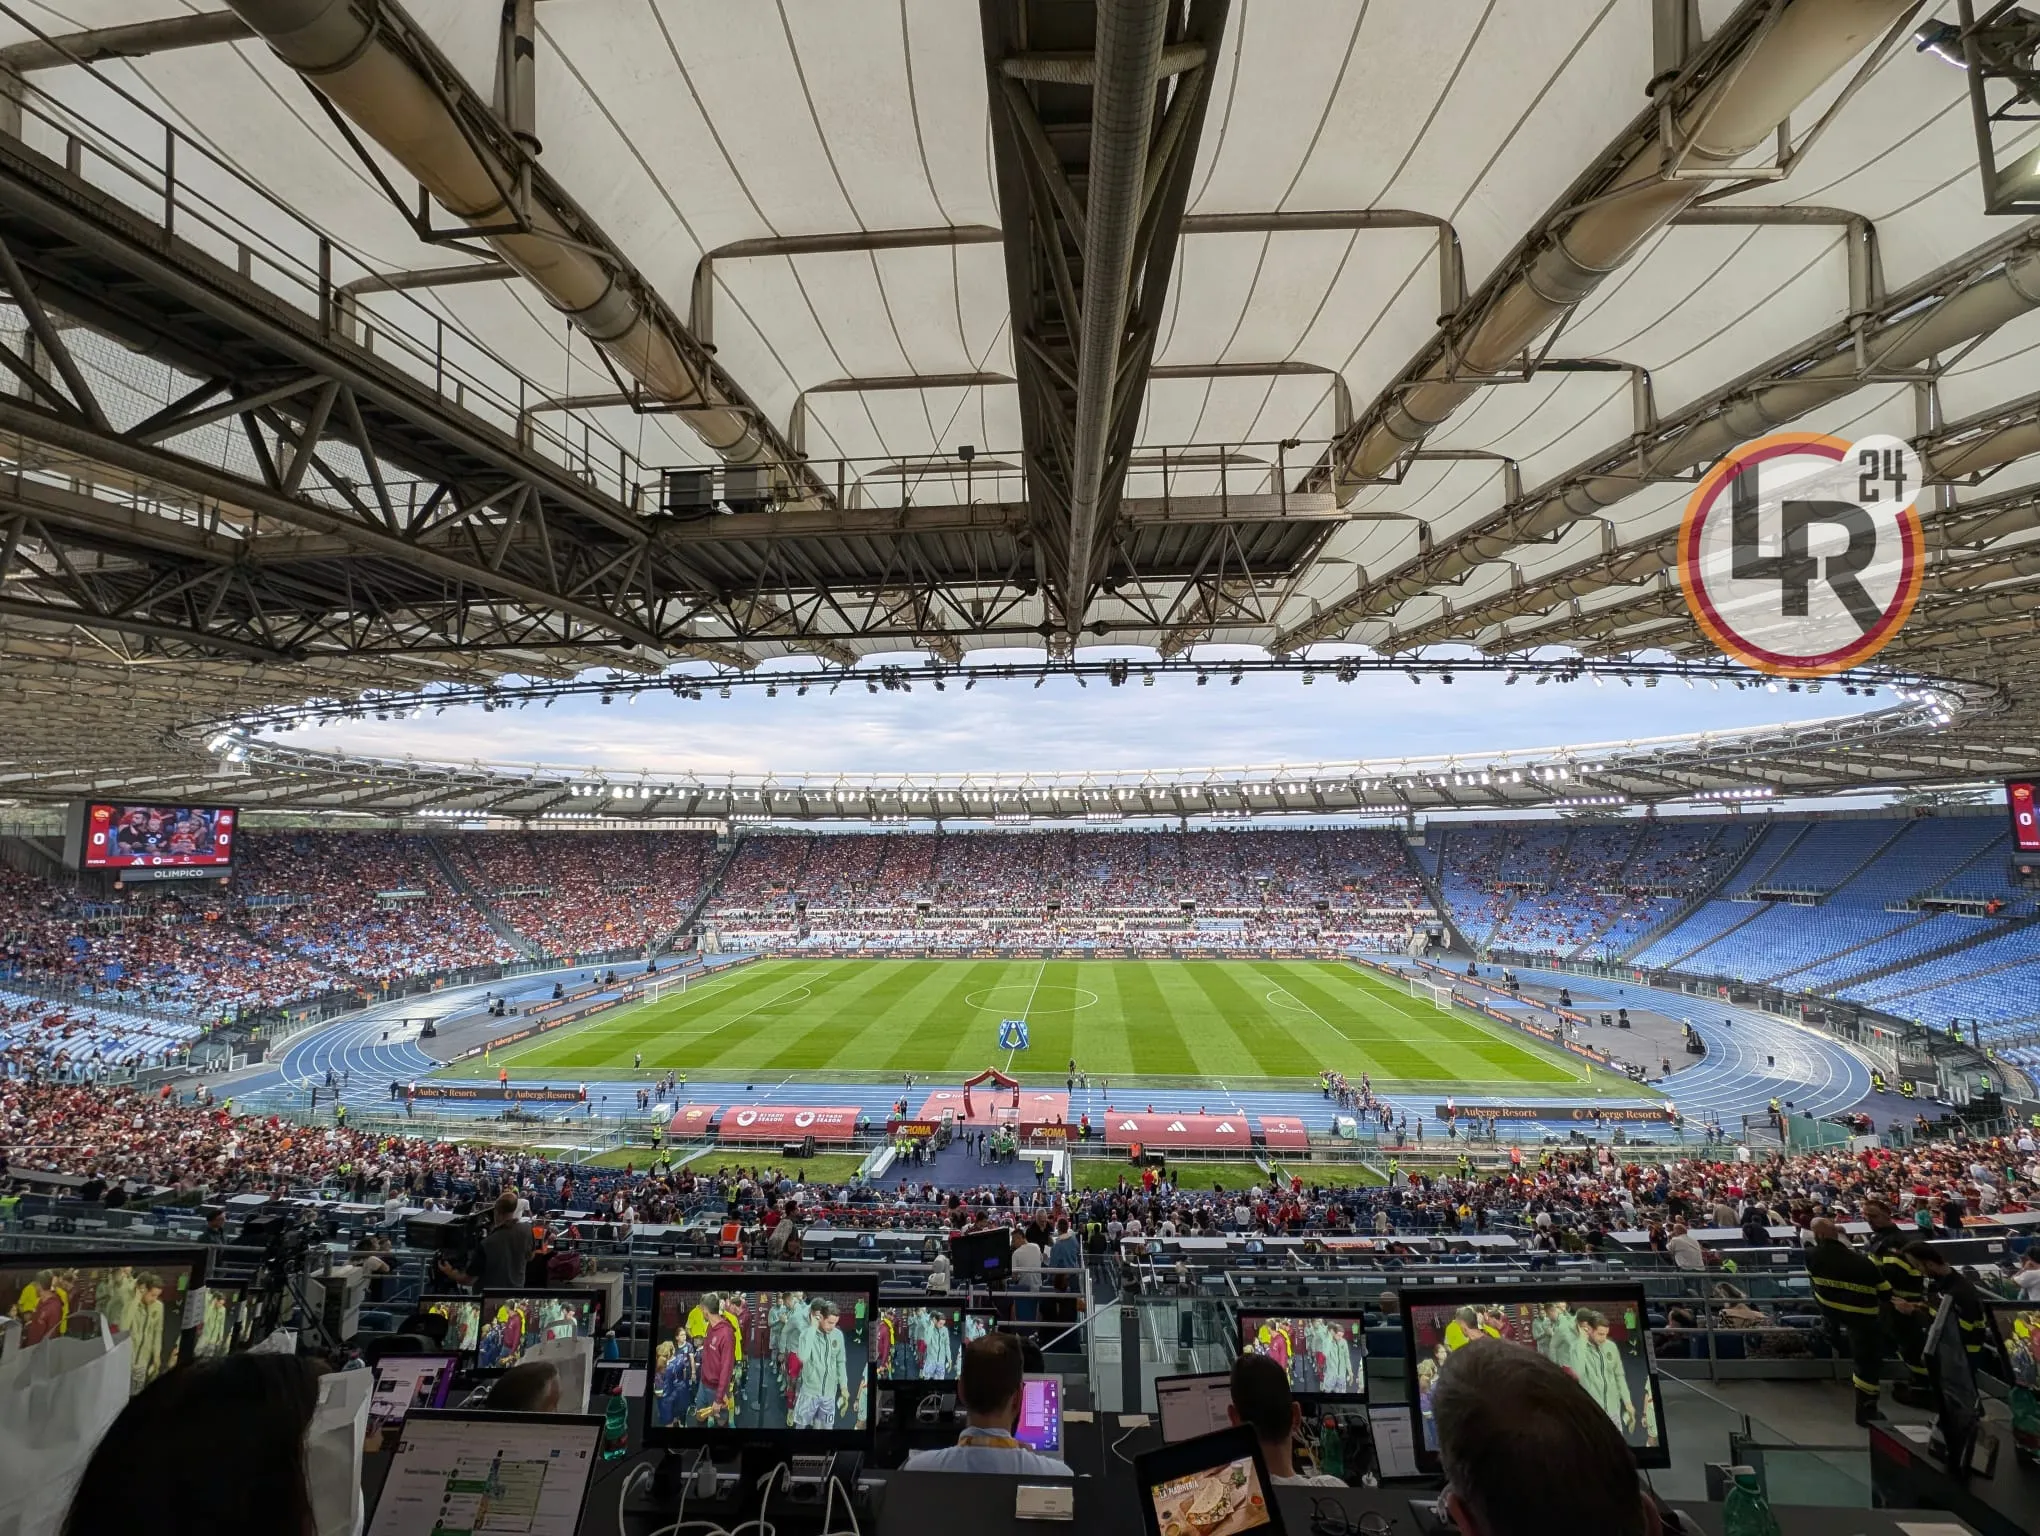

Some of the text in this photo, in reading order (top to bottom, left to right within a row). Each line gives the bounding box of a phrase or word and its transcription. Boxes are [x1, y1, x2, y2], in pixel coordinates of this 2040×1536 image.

[2019, 812, 2032, 826] 0
[93, 832, 106, 846] 0
[218, 833, 230, 845] 0
[154, 869, 204, 878] OLIMPICO
[418, 1088, 477, 1097] Aubere Resorts
[515, 1091, 575, 1100] Auberge Resorts
[1502, 1108, 1537, 1117] Resorts
[1626, 1110, 1662, 1119] Resorts
